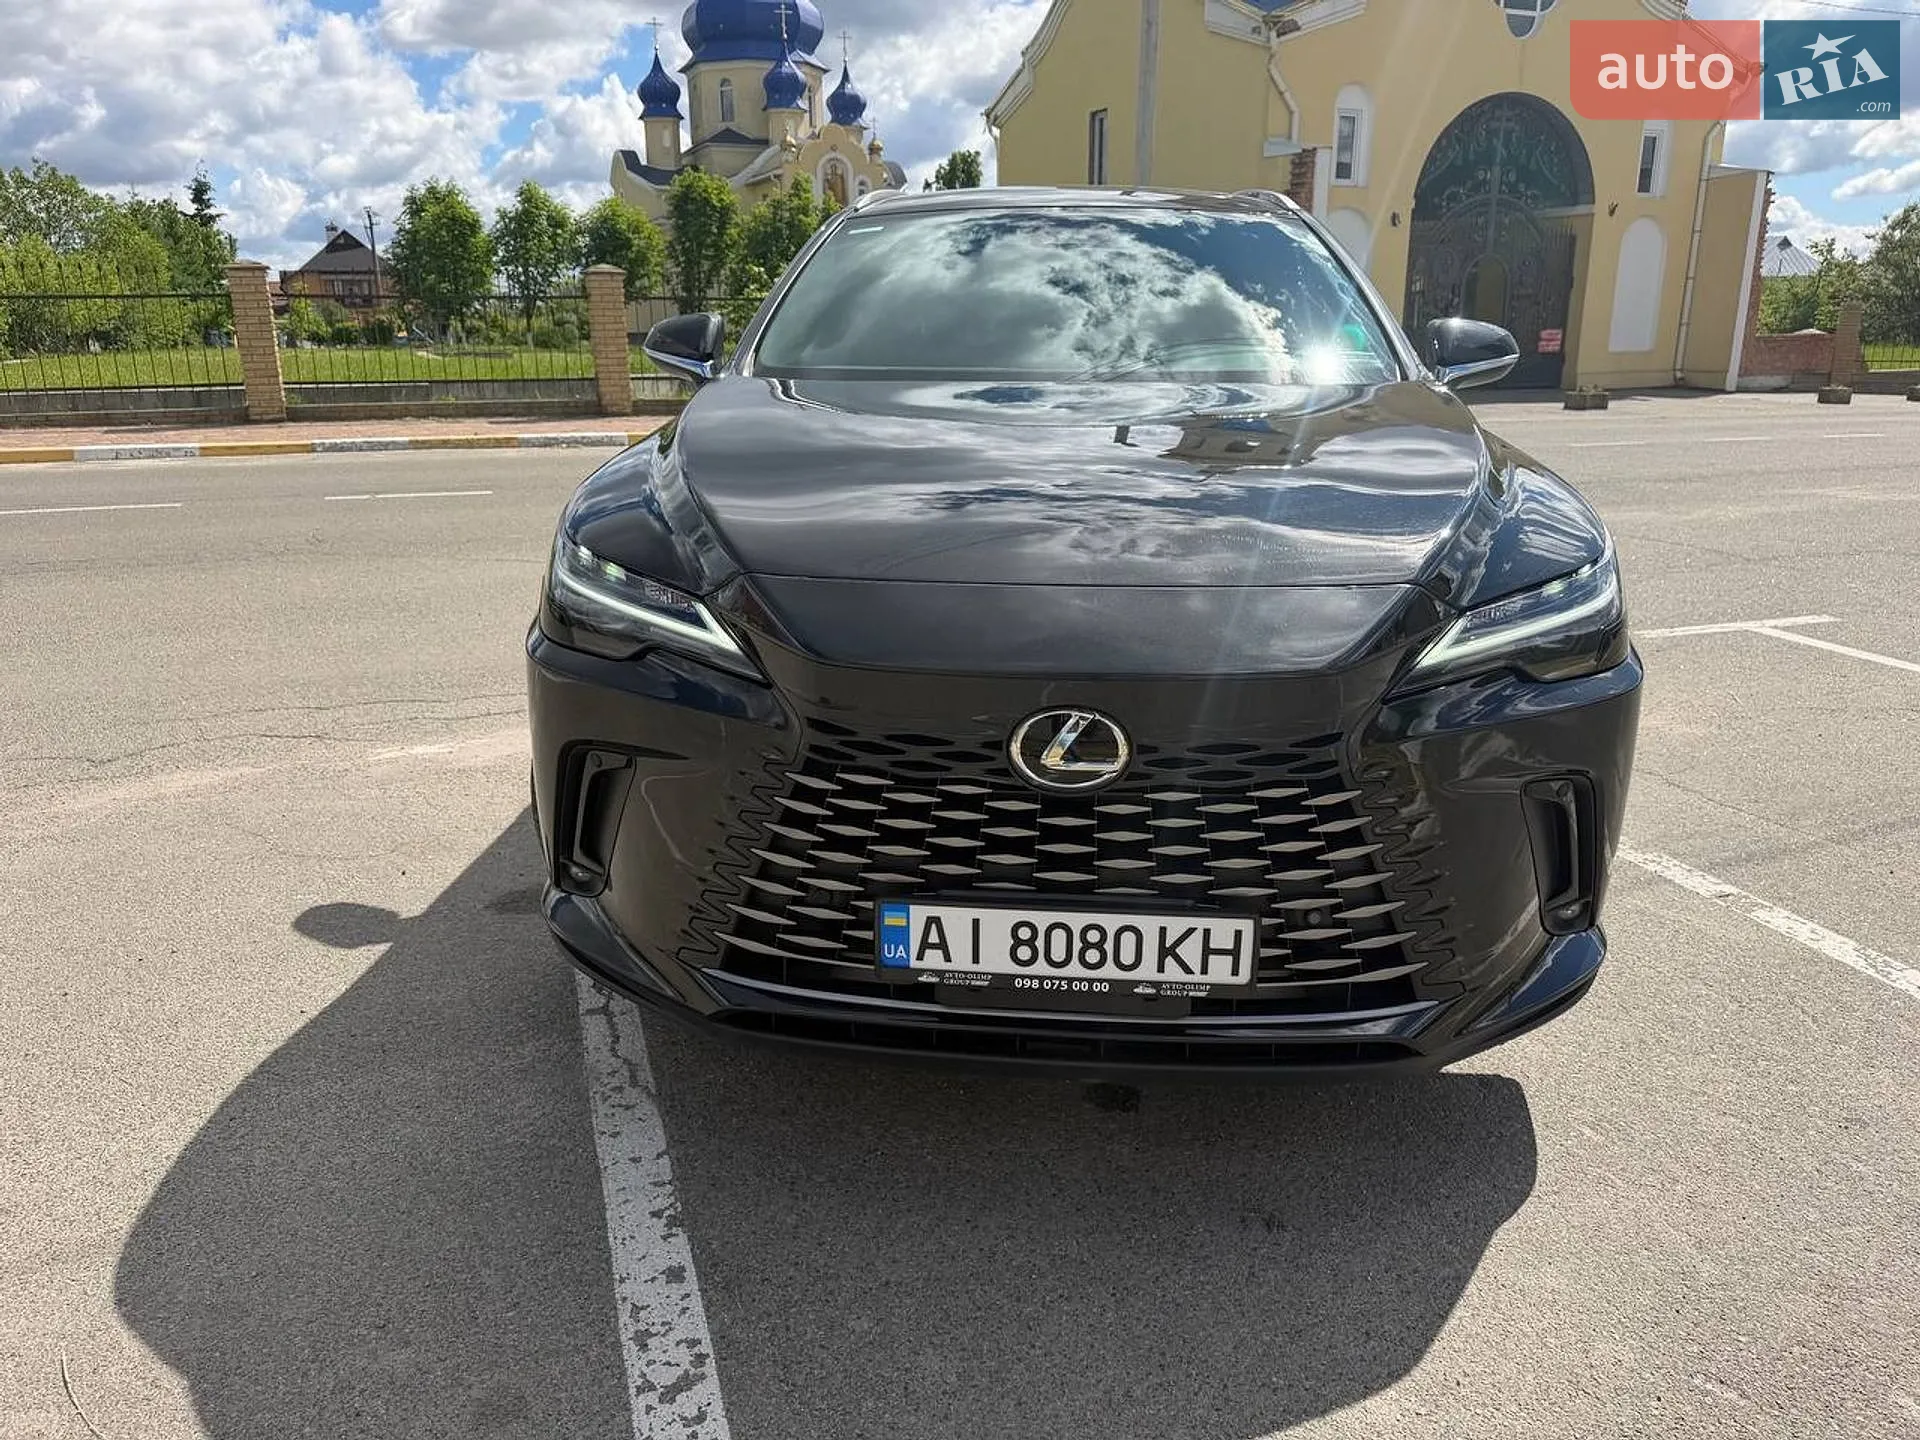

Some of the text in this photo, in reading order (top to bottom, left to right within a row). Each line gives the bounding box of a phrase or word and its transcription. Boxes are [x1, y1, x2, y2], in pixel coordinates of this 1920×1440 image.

[884, 944, 907, 959] UA
[1009, 920, 1144, 973] 8080
[1156, 925, 1244, 977] KH
[1014, 977, 1110, 993] 098 075 00 00
